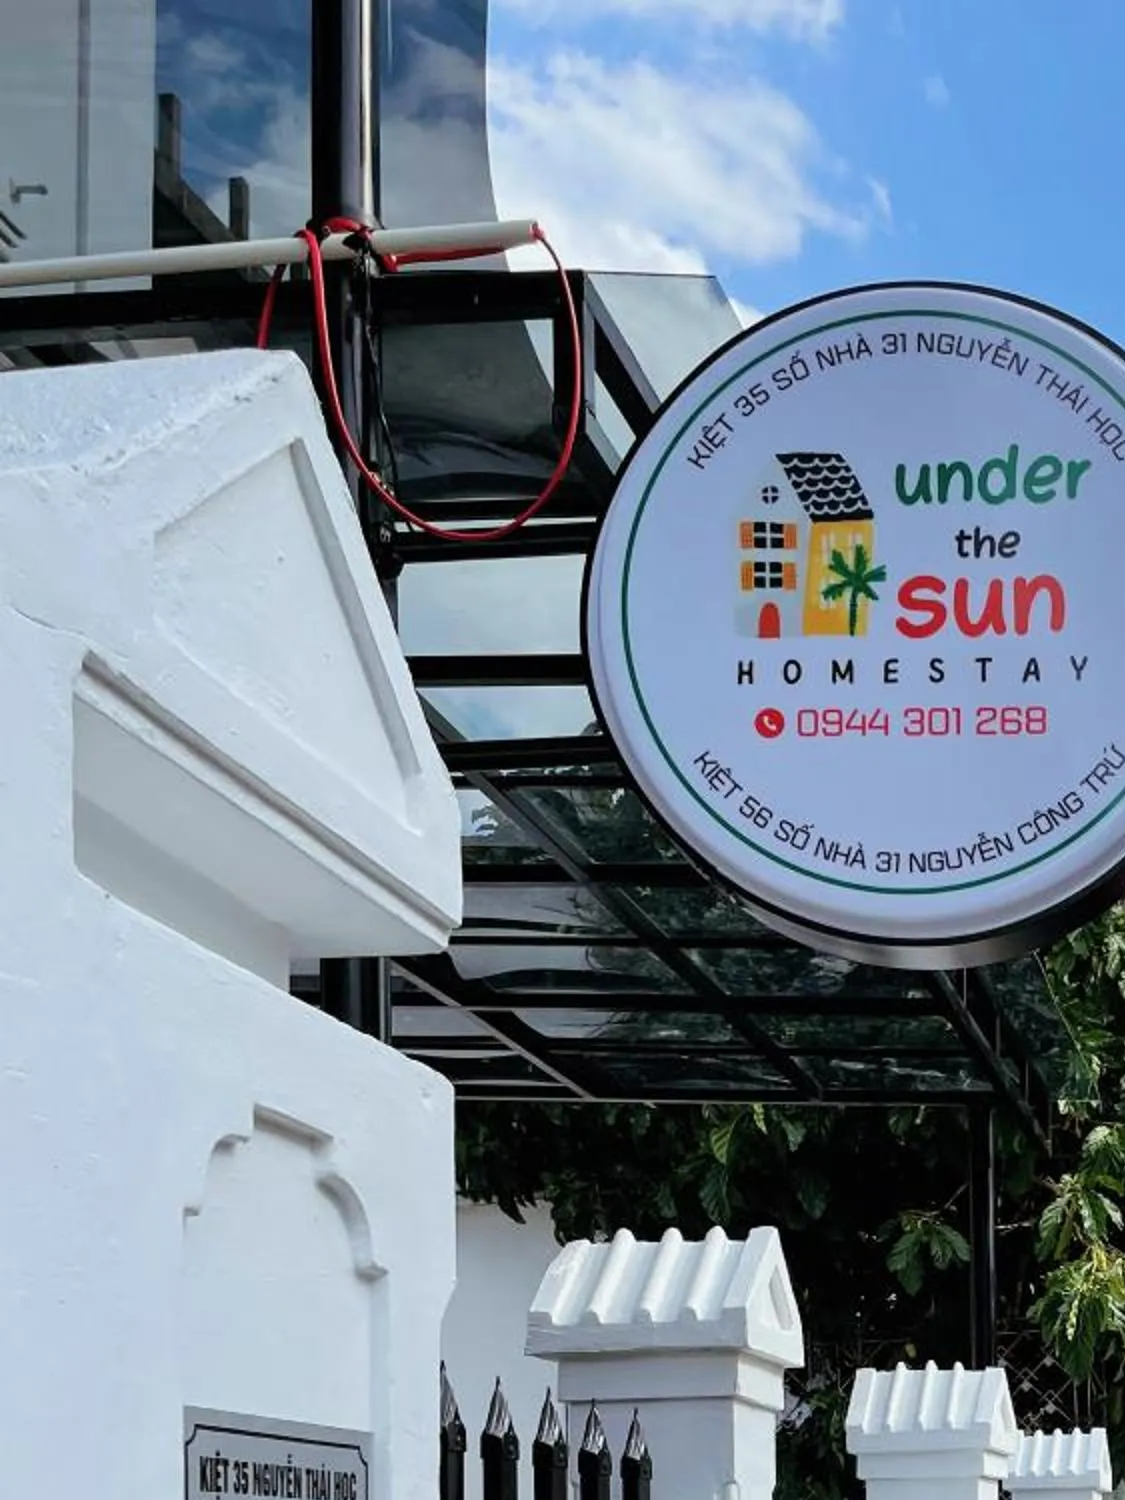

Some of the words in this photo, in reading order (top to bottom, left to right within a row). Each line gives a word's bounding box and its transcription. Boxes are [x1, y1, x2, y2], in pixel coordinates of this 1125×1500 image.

[687, 412, 735, 470] KIỆT
[734, 383, 770, 417] 35
[772, 352, 811, 391] SỐ
[815, 333, 872, 370] NHÀ
[882, 332, 907, 354] 31
[917, 332, 1029, 376] NGUYỄN
[1035, 363, 1089, 414] THÁI
[895, 444, 1092, 505] under
[955, 526, 1021, 558] the
[895, 575, 1066, 639] sun
[737, 655, 1089, 684] HOMESTAY
[797, 708, 889, 737] 0944
[903, 707, 962, 736] 301
[975, 706, 1048, 735] 268
[693, 751, 743, 799] KIỆT
[739, 795, 773, 829] 56
[774, 818, 815, 851] SỐ
[813, 836, 866, 870] NHÀ
[875, 851, 901, 873] 31
[909, 831, 1015, 874] NGUYỄN
[1017, 791, 1084, 845] CÔNG
[199, 1450, 229, 1500] KIỆT
[232, 1461, 249, 1495] 35
